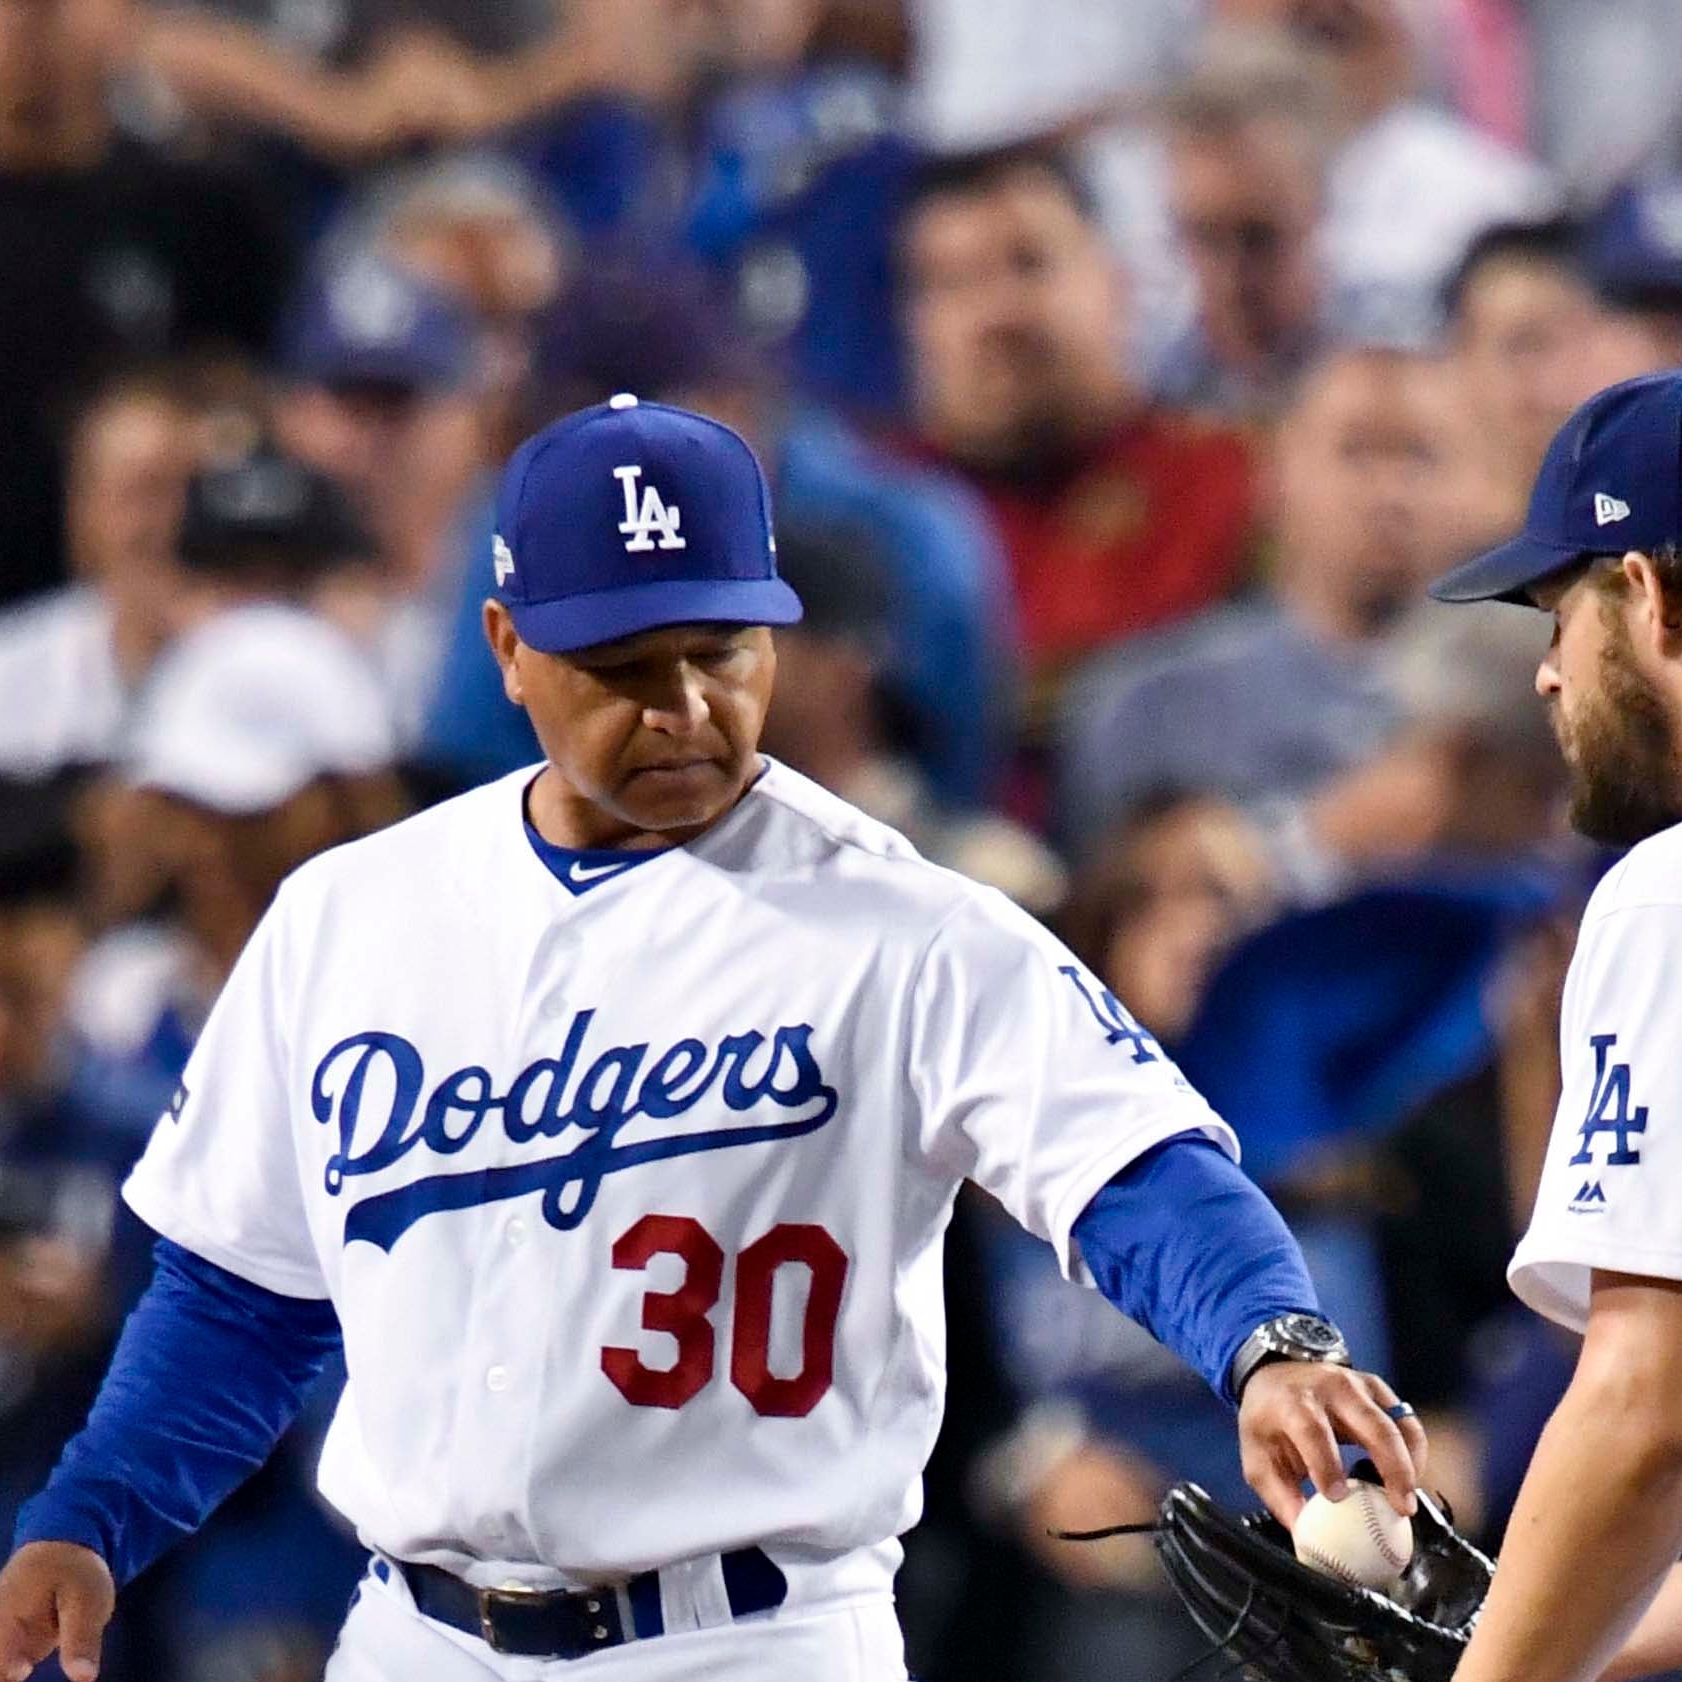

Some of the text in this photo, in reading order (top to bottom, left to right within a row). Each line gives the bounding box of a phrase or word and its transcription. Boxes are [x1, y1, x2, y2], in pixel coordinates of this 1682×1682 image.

[613, 465, 686, 552] LA
[311, 1008, 839, 1235] Dodgers
[1568, 1033, 1649, 1167] LA
[600, 1213, 849, 1418] 30
